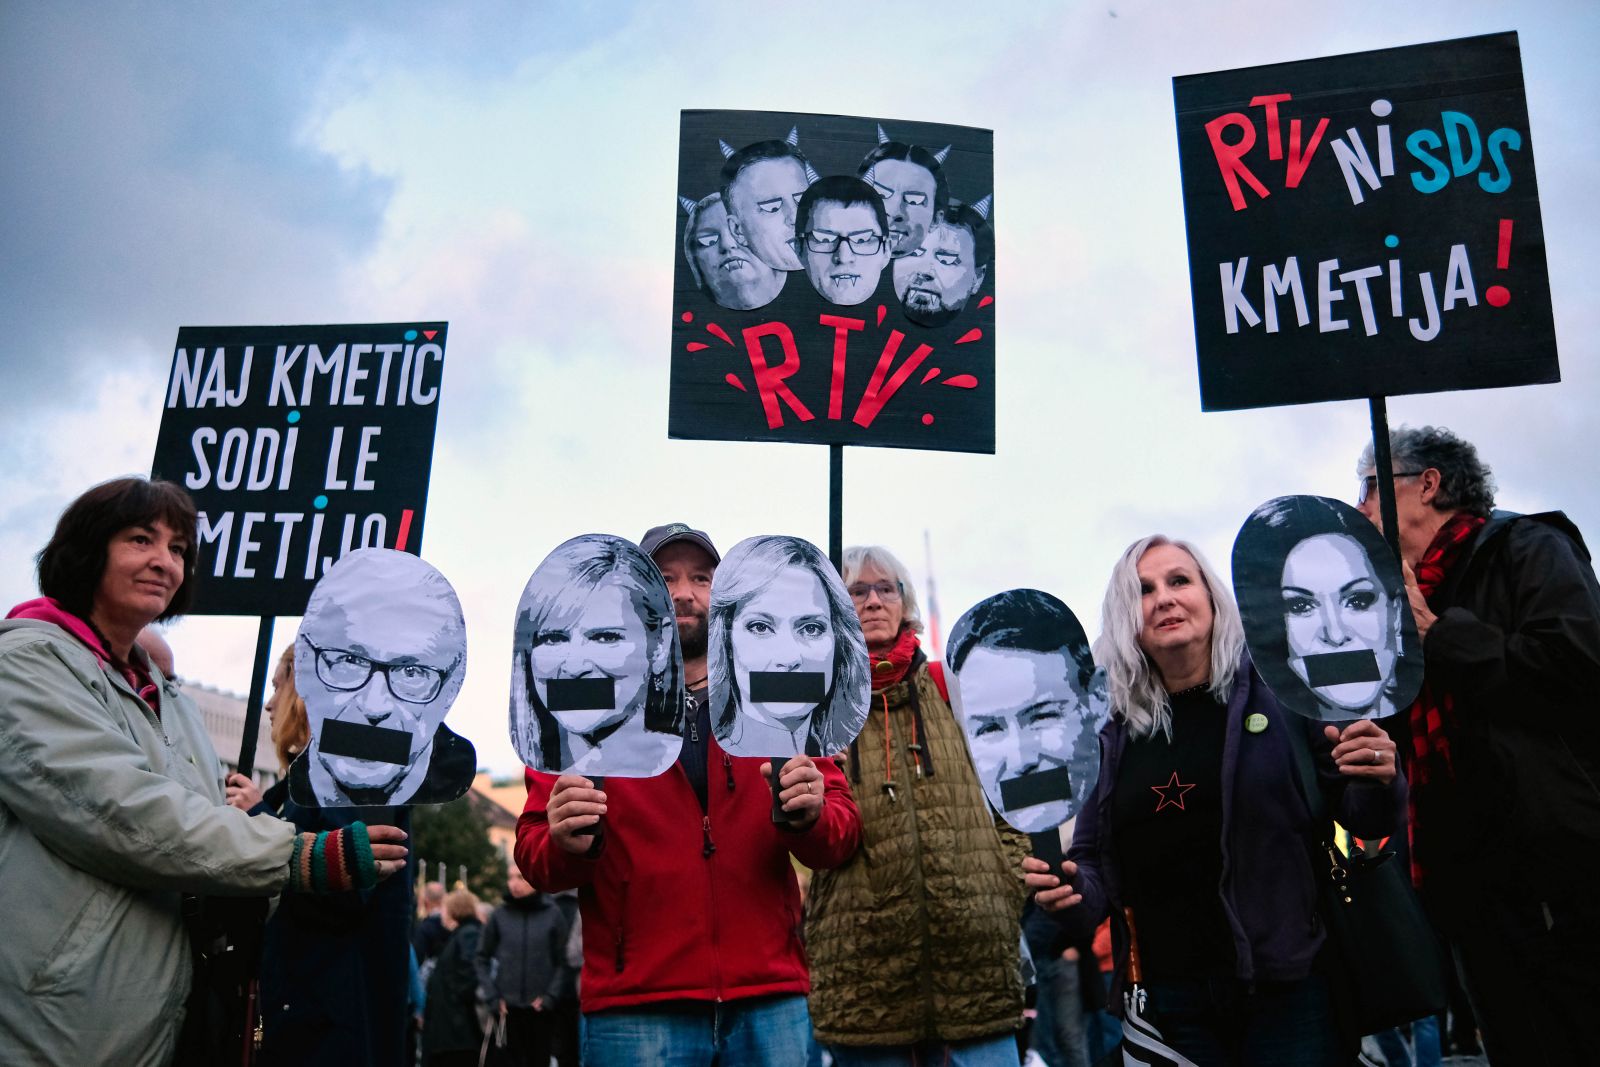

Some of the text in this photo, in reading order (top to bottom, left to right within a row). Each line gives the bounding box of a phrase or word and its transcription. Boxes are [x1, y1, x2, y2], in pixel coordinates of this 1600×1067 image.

[1204, 93, 1330, 212] RTV
[1405, 111, 1522, 194] SDS
[167, 345, 255, 408] NAJ
[741, 313, 935, 430] RTV
[324, 426, 382, 491] LE
